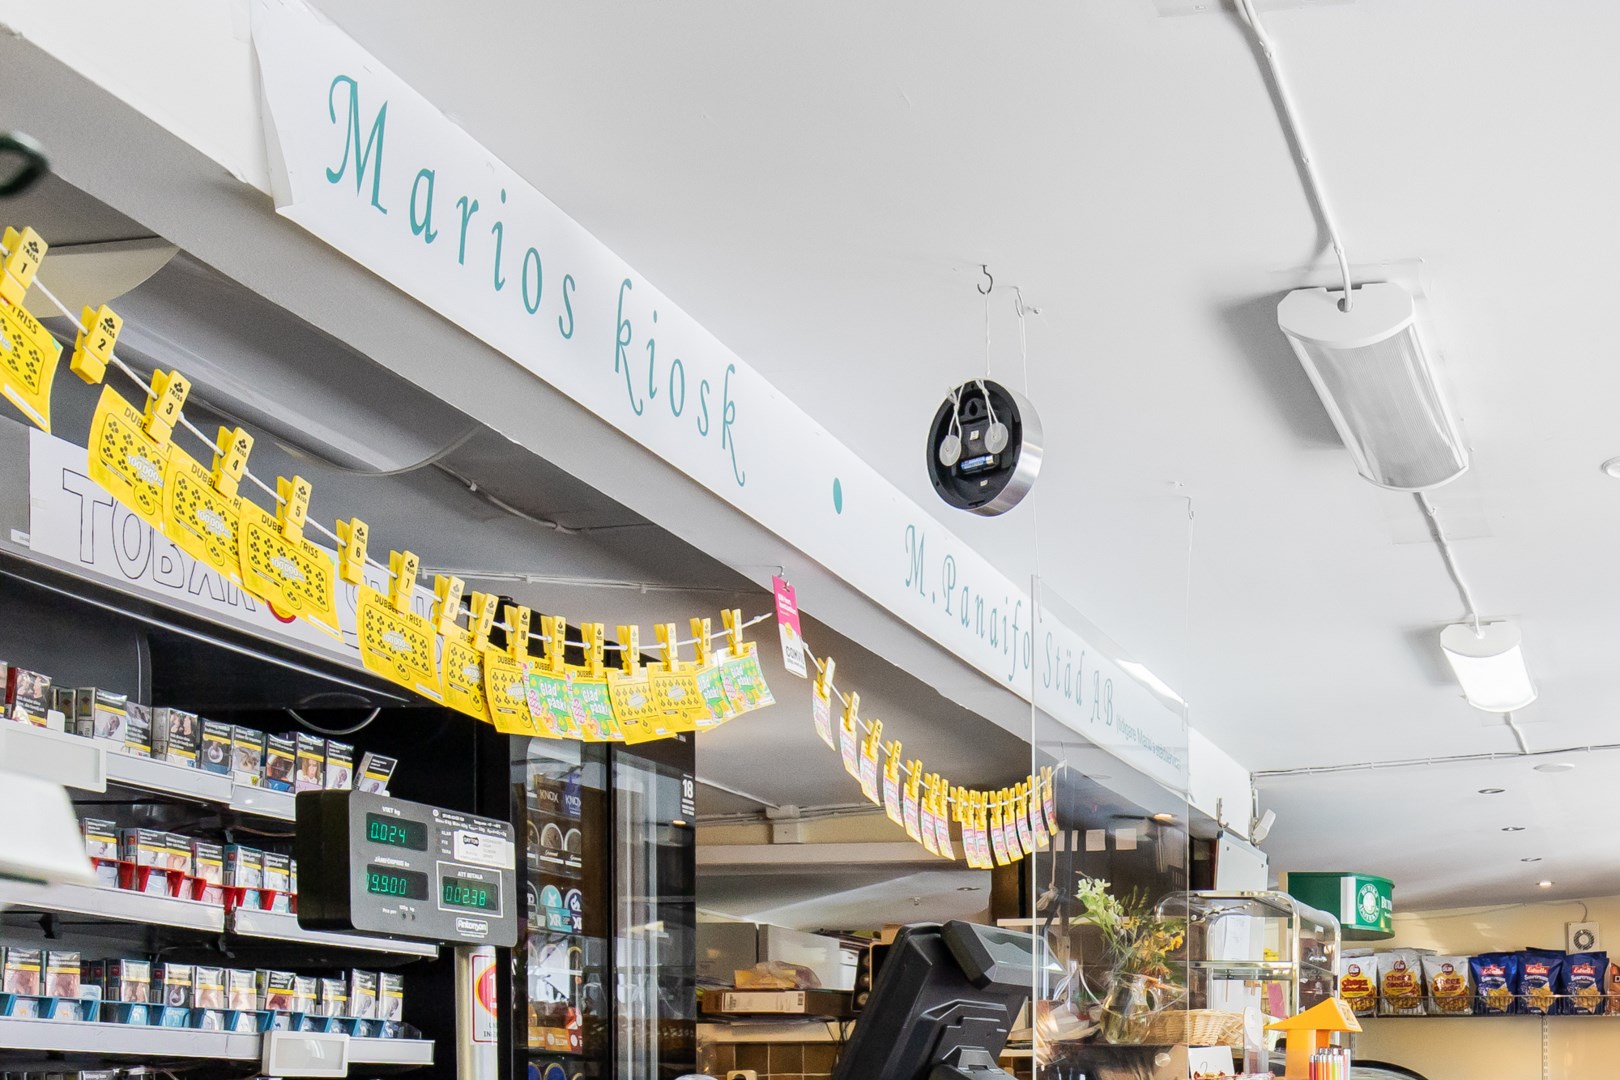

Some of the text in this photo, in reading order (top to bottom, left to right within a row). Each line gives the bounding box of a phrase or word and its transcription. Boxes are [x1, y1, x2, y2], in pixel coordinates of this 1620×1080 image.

[22, 245, 38, 264] TRISS
[20, 262, 28, 274] 1
[326, 74, 746, 487] Marios kiosk
[11, 305, 38, 335] TRISS
[99, 320, 116, 339] TRISS
[97, 338, 107, 352] 2
[168, 385, 183, 403] TRISS
[165, 402, 174, 415] 3
[234, 444, 247, 459] TRISS
[231, 457, 239, 472] 4
[294, 505, 301, 518] 5
[354, 545, 362, 559] 6
[409, 614, 423, 628] RISS
[519, 630, 527, 641] 10
[1043, 631, 1085, 707] Städ
[1090, 669, 1114, 727] AB
[682, 777, 694, 799] 18
[540, 788, 560, 804] KNOX
